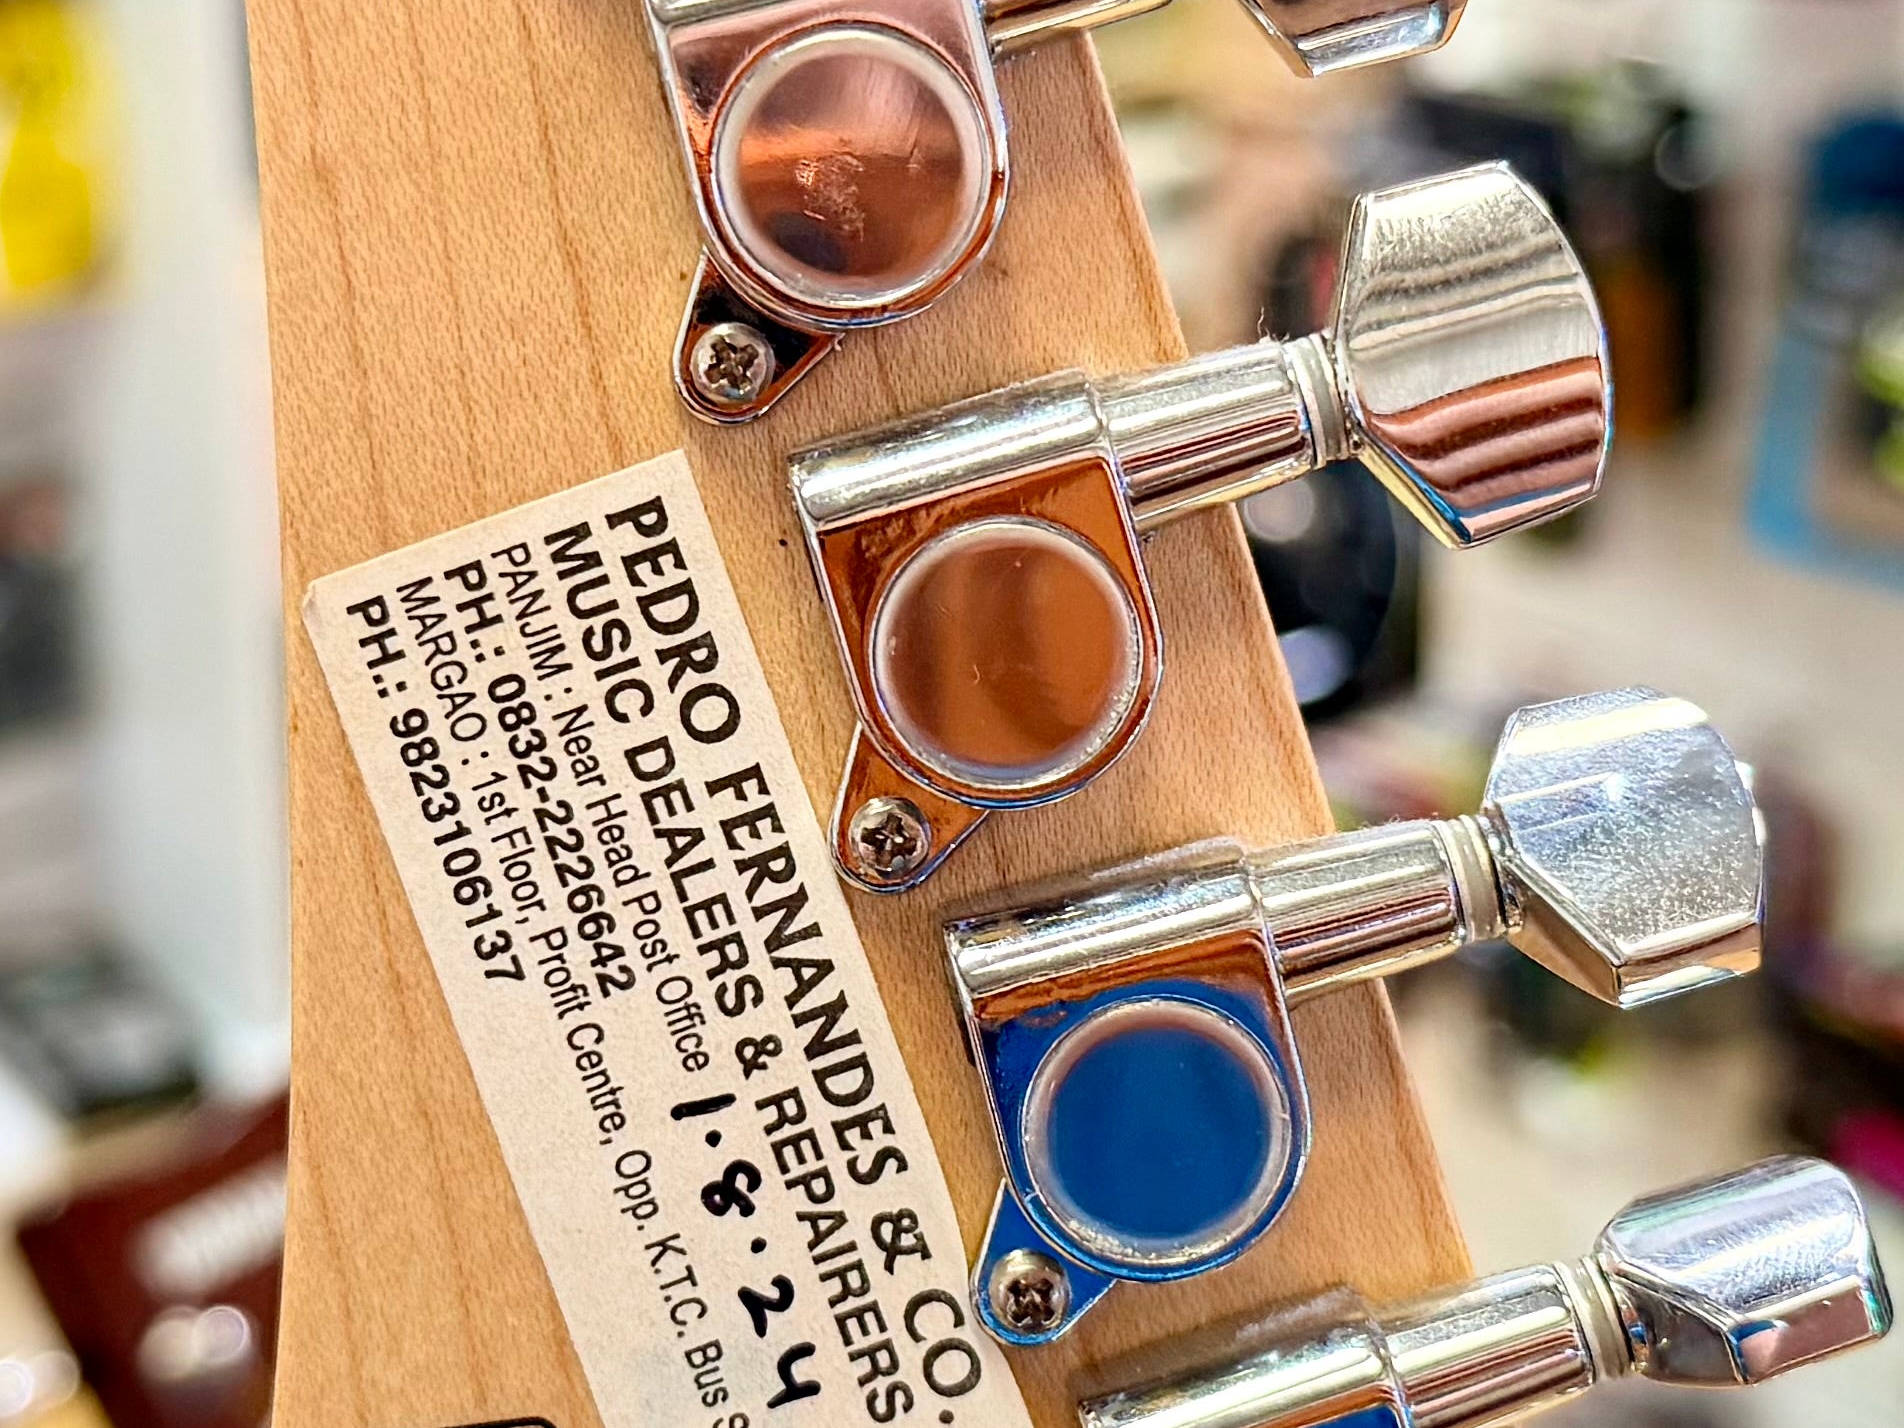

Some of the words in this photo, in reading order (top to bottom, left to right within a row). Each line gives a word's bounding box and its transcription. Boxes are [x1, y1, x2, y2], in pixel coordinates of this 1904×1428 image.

[395, 576, 488, 743] MARGAO
[543, 521, 655, 724] MUSIC
[389, 707, 526, 981] 9823106137
[471, 771, 519, 826] 1st
[487, 673, 637, 999] 0832-2226642
[490, 542, 574, 682] PANJIM
[551, 703, 607, 787] Near
[585, 792, 652, 889] Head
[621, 890, 681, 973] Post
[655, 975, 710, 1073] Office
[490, 825, 547, 925] Floor,
[623, 735, 764, 1018] DEALERS
[528, 926, 592, 1021] Profit
[604, 495, 741, 745] PEDRO
[703, 761, 909, 1186] FERNANDES
[870, 1208, 933, 1276] &
[903, 1288, 982, 1425] CO.
[566, 1022, 626, 1146] Centre,
[734, 1034, 783, 1081] &
[613, 1149, 659, 1231] Opp.
[754, 1086, 914, 1424] REPAIRERS
[644, 1233, 708, 1338] K.T.C.
[684, 1339, 729, 1408] Bus
